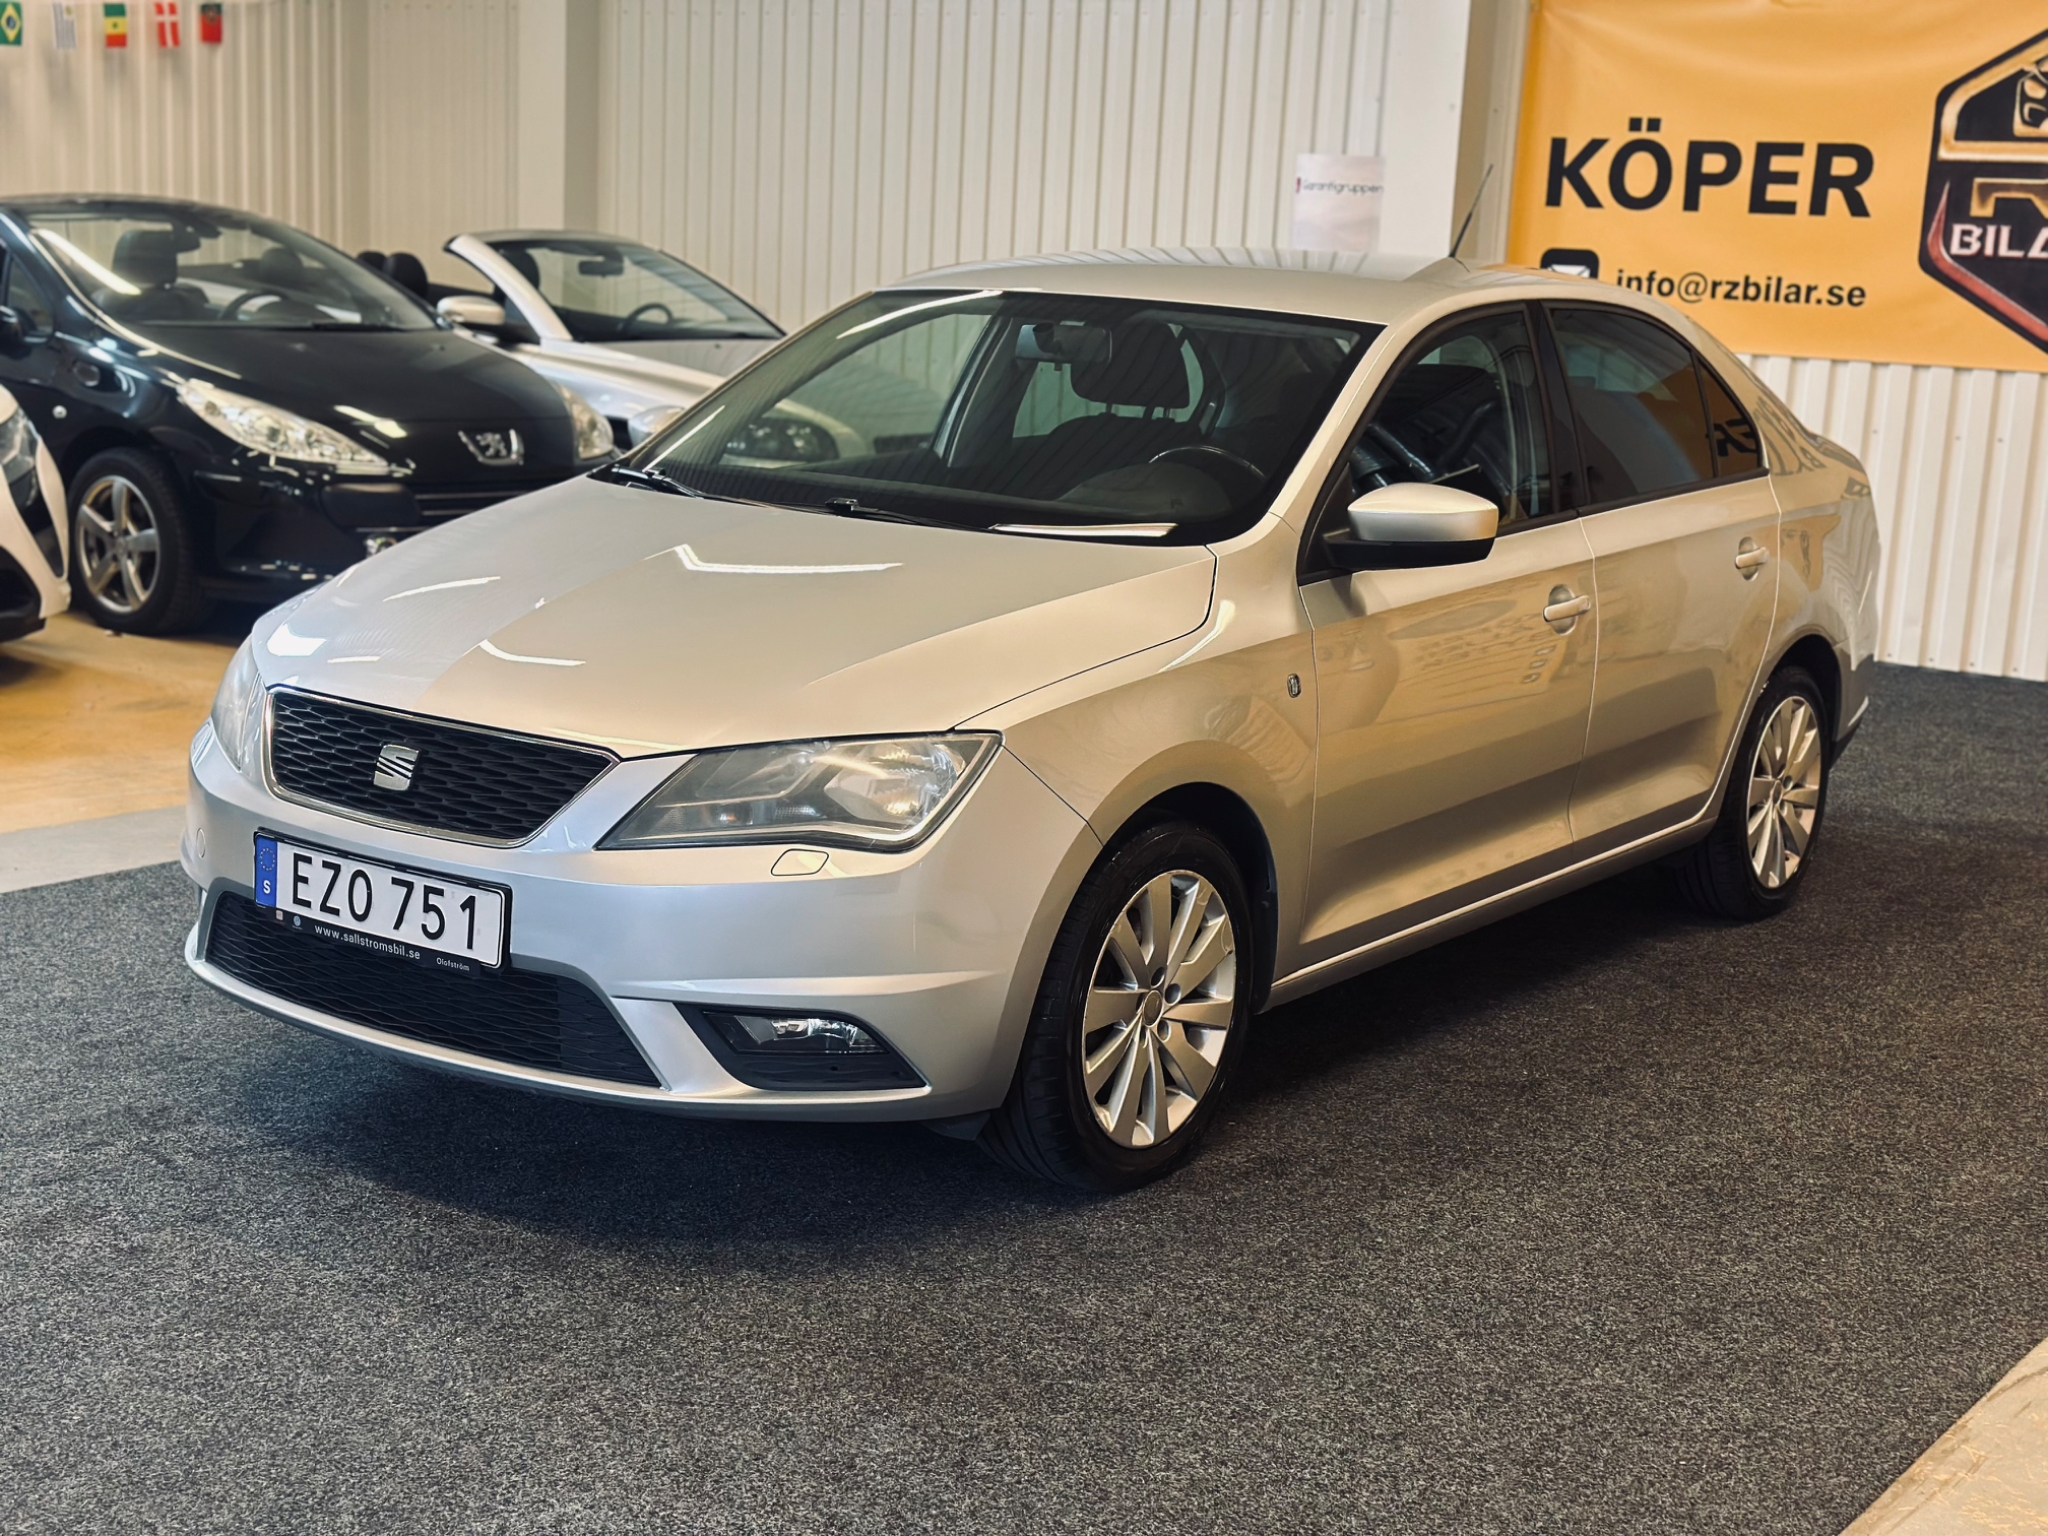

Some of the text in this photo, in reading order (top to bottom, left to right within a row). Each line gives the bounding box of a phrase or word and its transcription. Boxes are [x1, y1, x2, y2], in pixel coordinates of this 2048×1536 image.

[1545, 117, 1875, 218] KÖPER
[1616, 269, 1867, 307] info@rzbilar.se
[263, 880, 271, 894] S
[292, 852, 477, 951] EZO 751
[314, 925, 421, 960] www.sallstromsbil.se
